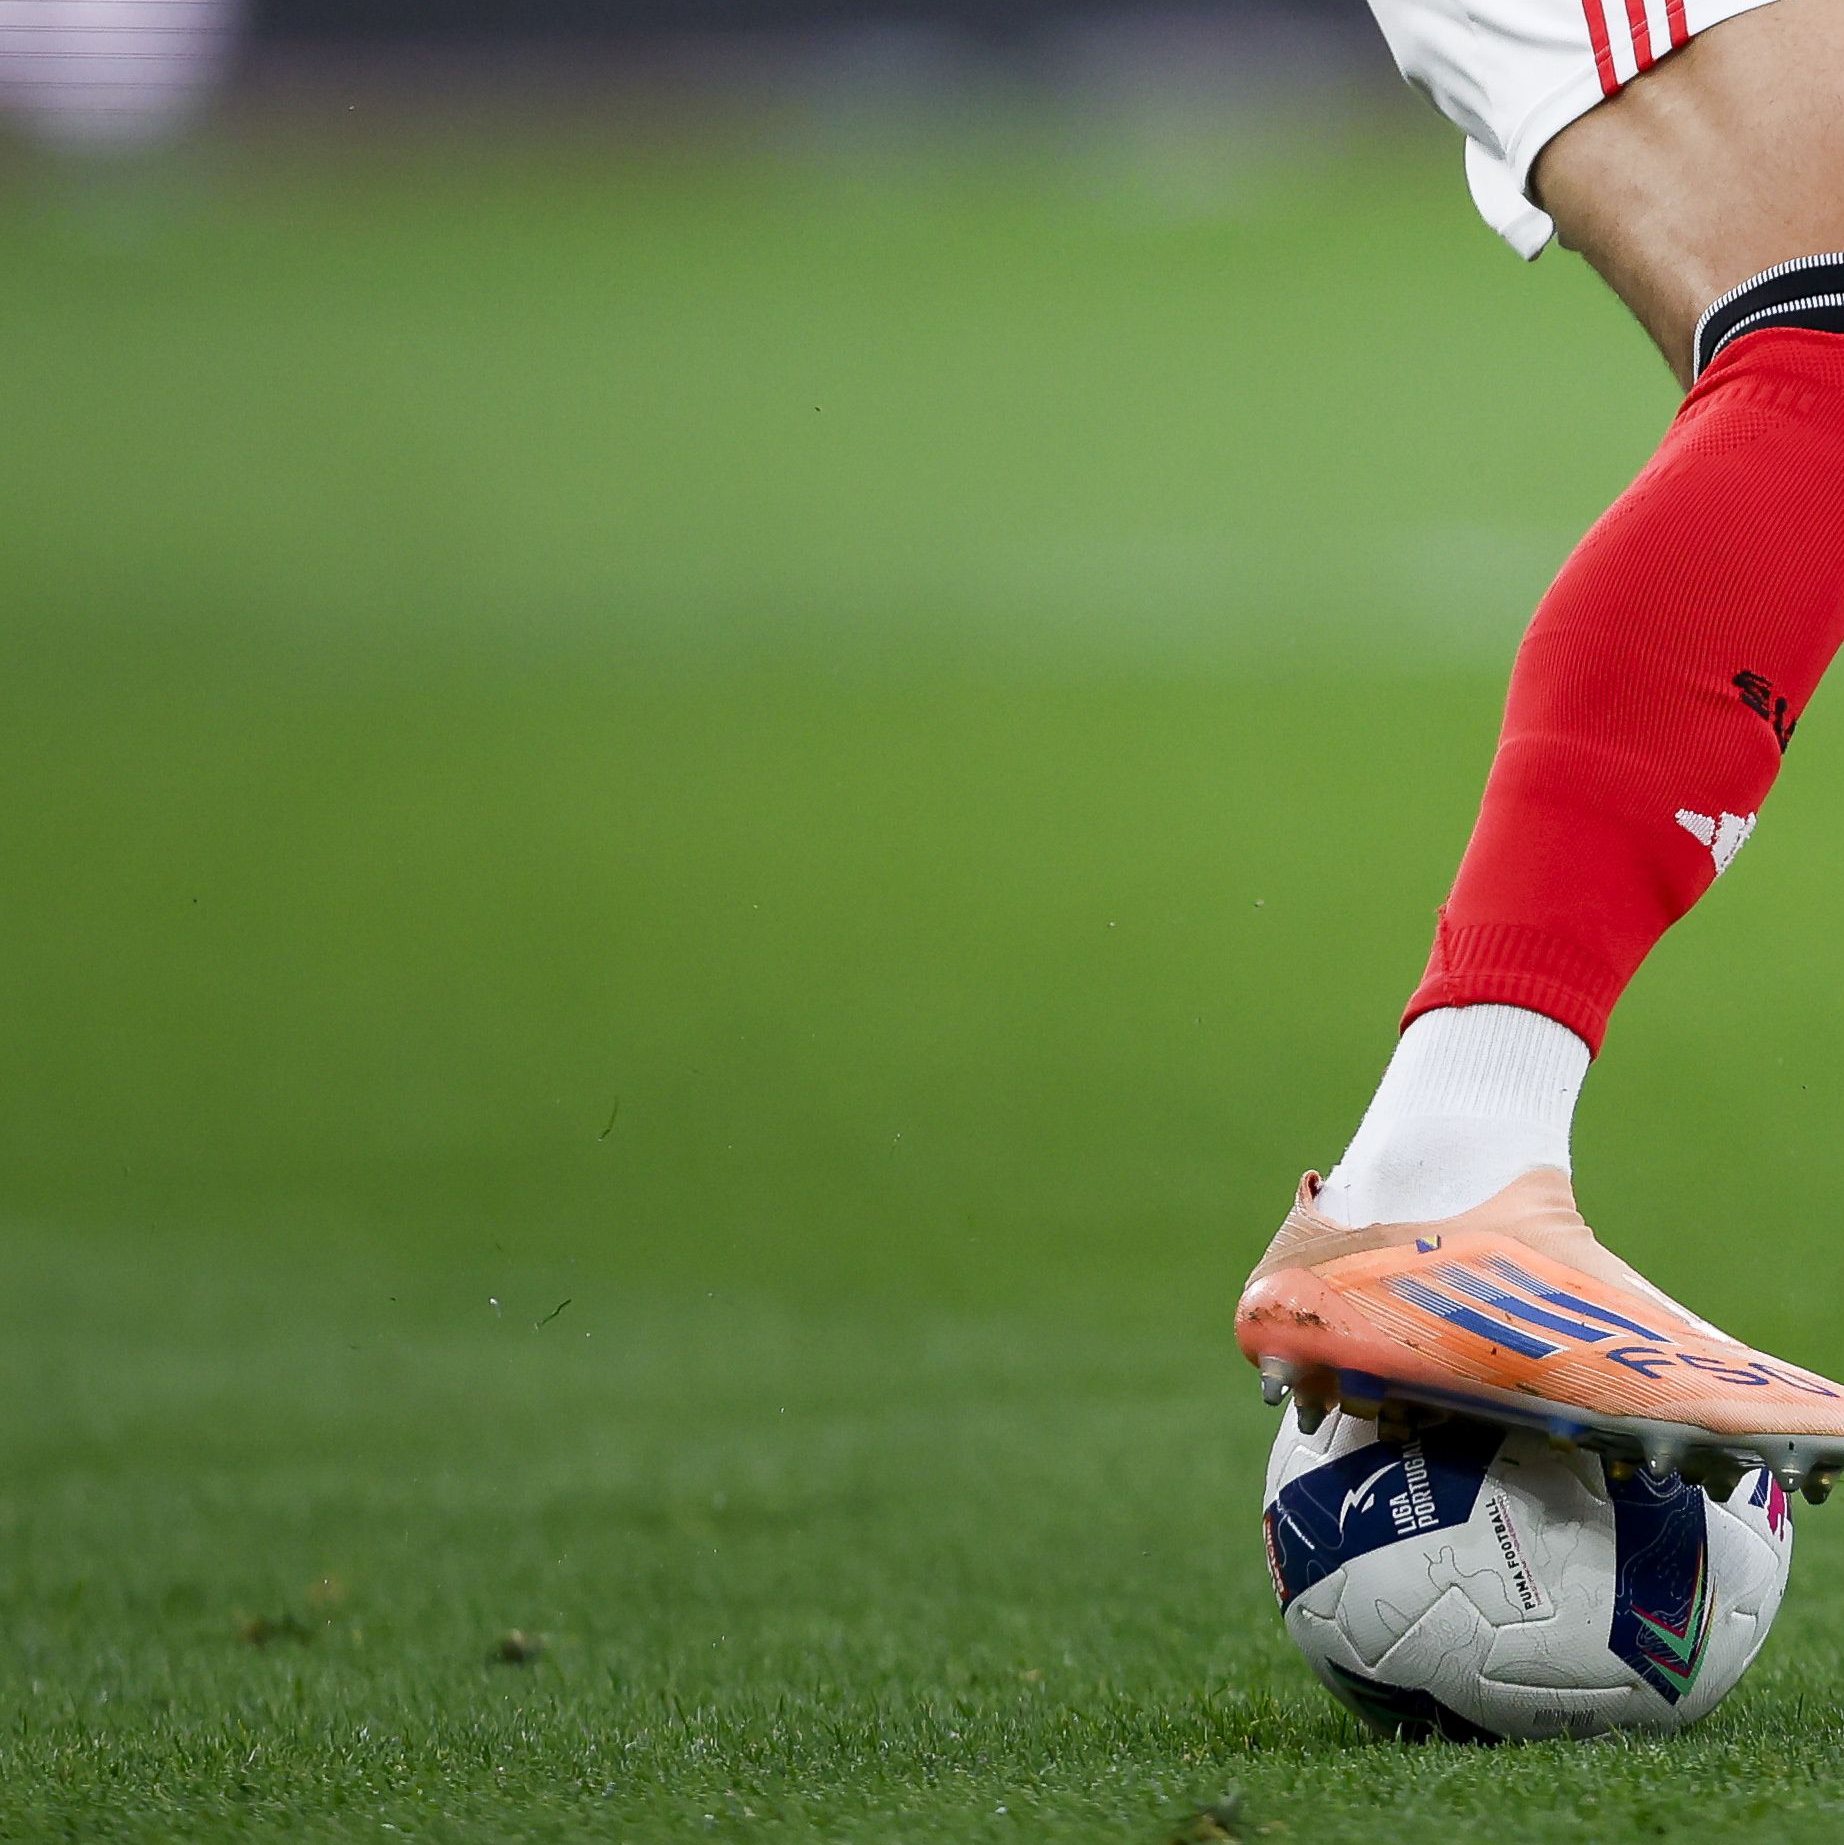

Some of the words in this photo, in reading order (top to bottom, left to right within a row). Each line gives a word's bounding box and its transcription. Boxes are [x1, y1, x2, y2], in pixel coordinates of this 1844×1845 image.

[1400, 1434, 1441, 1529] PORTUGAL
[1389, 1491, 1418, 1536] LIGA
[1484, 1496, 1520, 1569] FOOTBALL
[1513, 1570, 1537, 1612] PUMA
